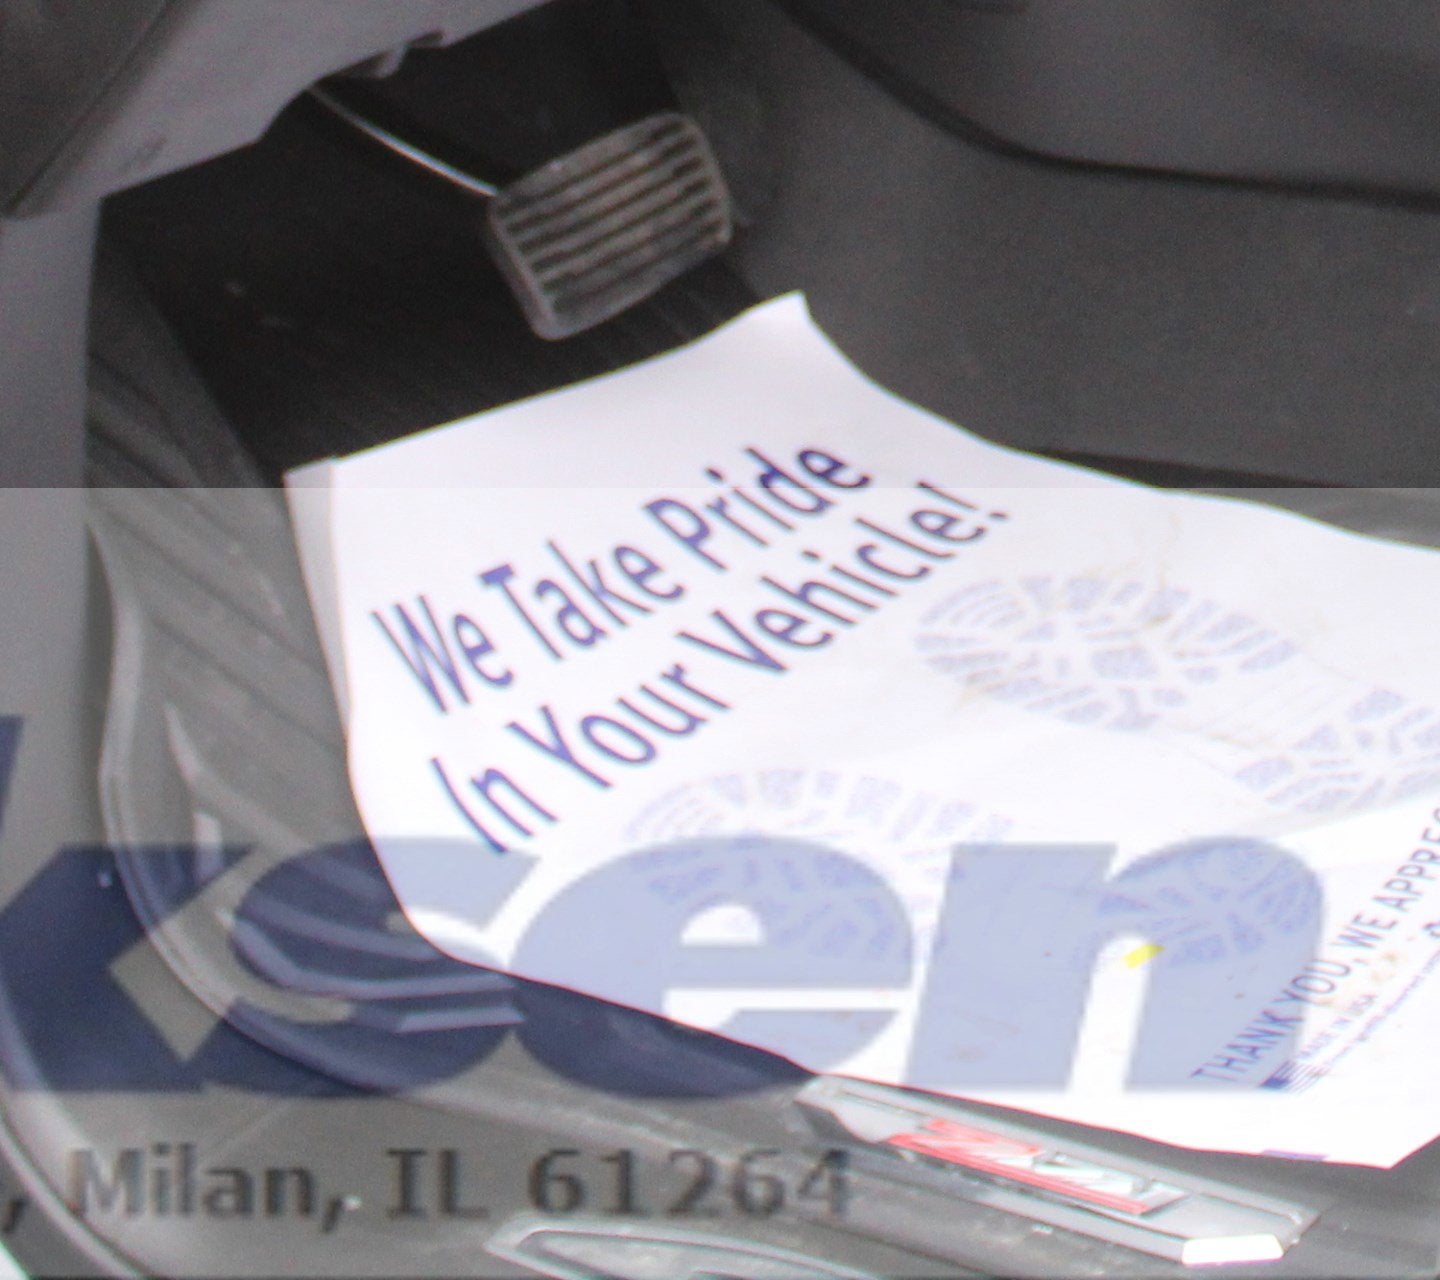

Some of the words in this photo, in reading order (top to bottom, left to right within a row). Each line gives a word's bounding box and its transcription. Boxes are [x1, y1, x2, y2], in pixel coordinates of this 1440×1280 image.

[371, 595, 494, 714] We
[479, 539, 686, 660] Take
[643, 446, 872, 571] Pride
[430, 757, 559, 855] In
[506, 662, 732, 788] Your
[675, 480, 1010, 673] Vehicle!
[1190, 1008, 1305, 1081] THANK
[1330, 912, 1397, 950] WE
